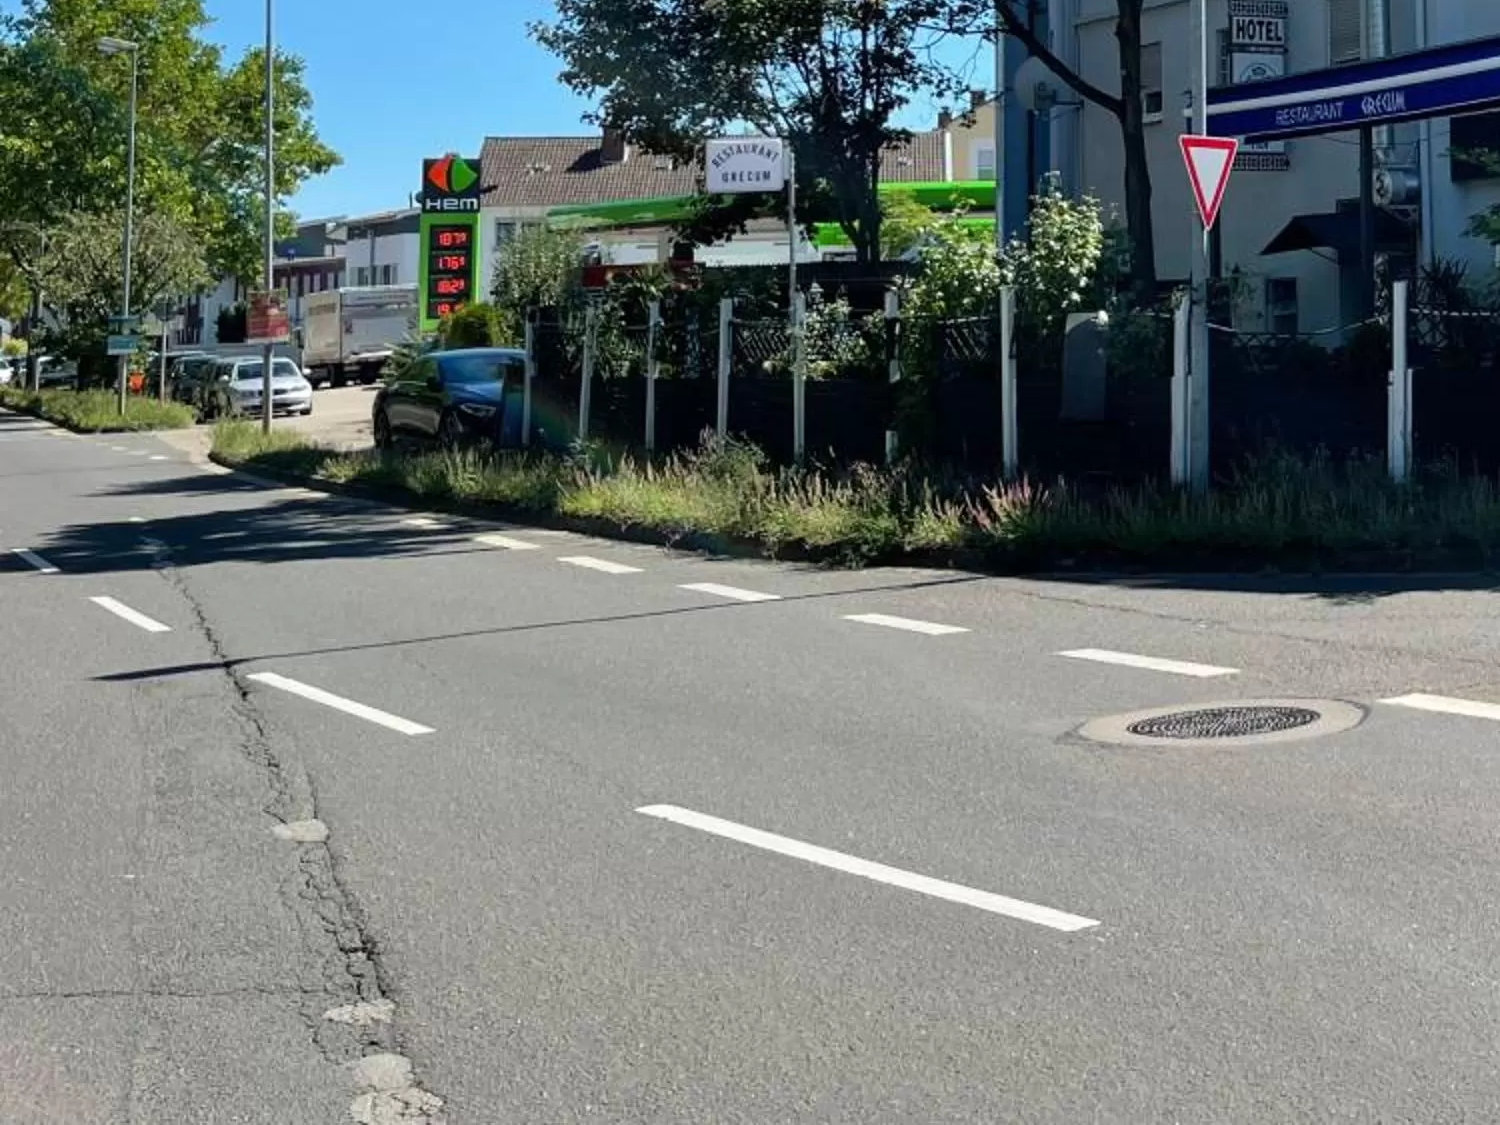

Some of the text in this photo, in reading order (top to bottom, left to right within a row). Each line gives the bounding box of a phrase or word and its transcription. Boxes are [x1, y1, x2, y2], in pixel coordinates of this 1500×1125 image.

[1236, 19, 1283, 42] HOTEL
[1275, 101, 1344, 126] RESTAURANT
[711, 143, 779, 169] RESTAURANT
